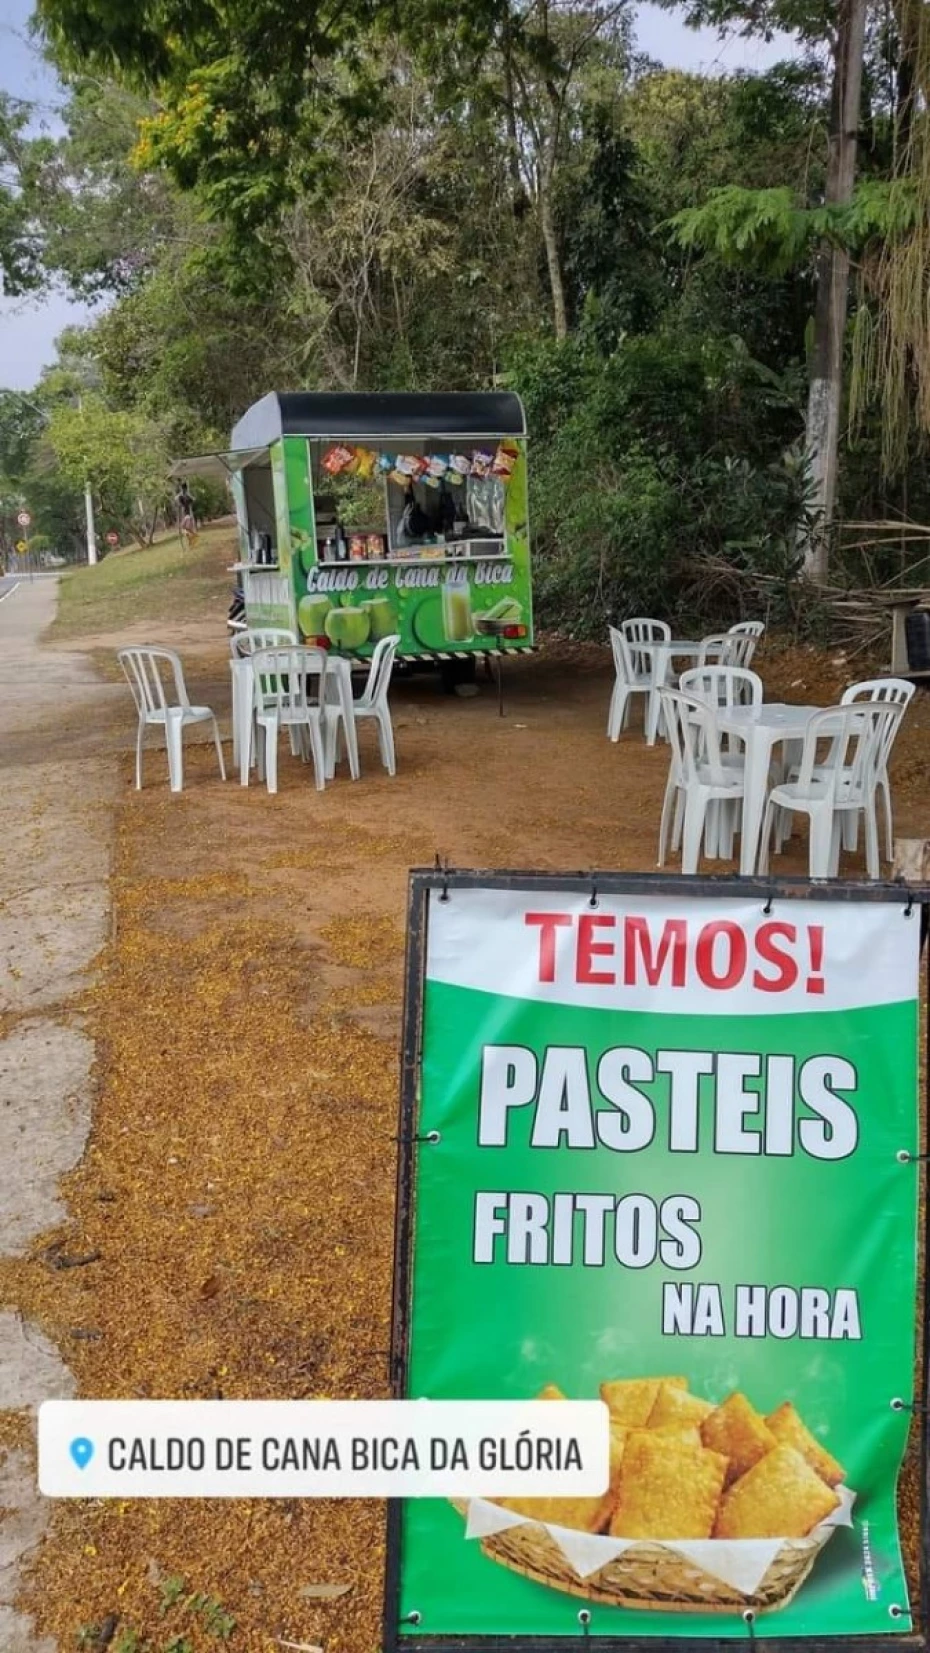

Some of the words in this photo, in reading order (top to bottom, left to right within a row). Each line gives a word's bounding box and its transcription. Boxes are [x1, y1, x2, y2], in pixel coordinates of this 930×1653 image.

[306, 567, 358, 592] Caldo
[365, 567, 389, 589] de
[395, 564, 439, 588] Cana
[474, 561, 514, 584] Bica
[524, 911, 826, 995] TEMOS!
[477, 1043, 858, 1160] PASTEIS
[472, 1191, 702, 1271] FRITOS
[661, 1282, 726, 1336] NA
[734, 1283, 863, 1340] HORA
